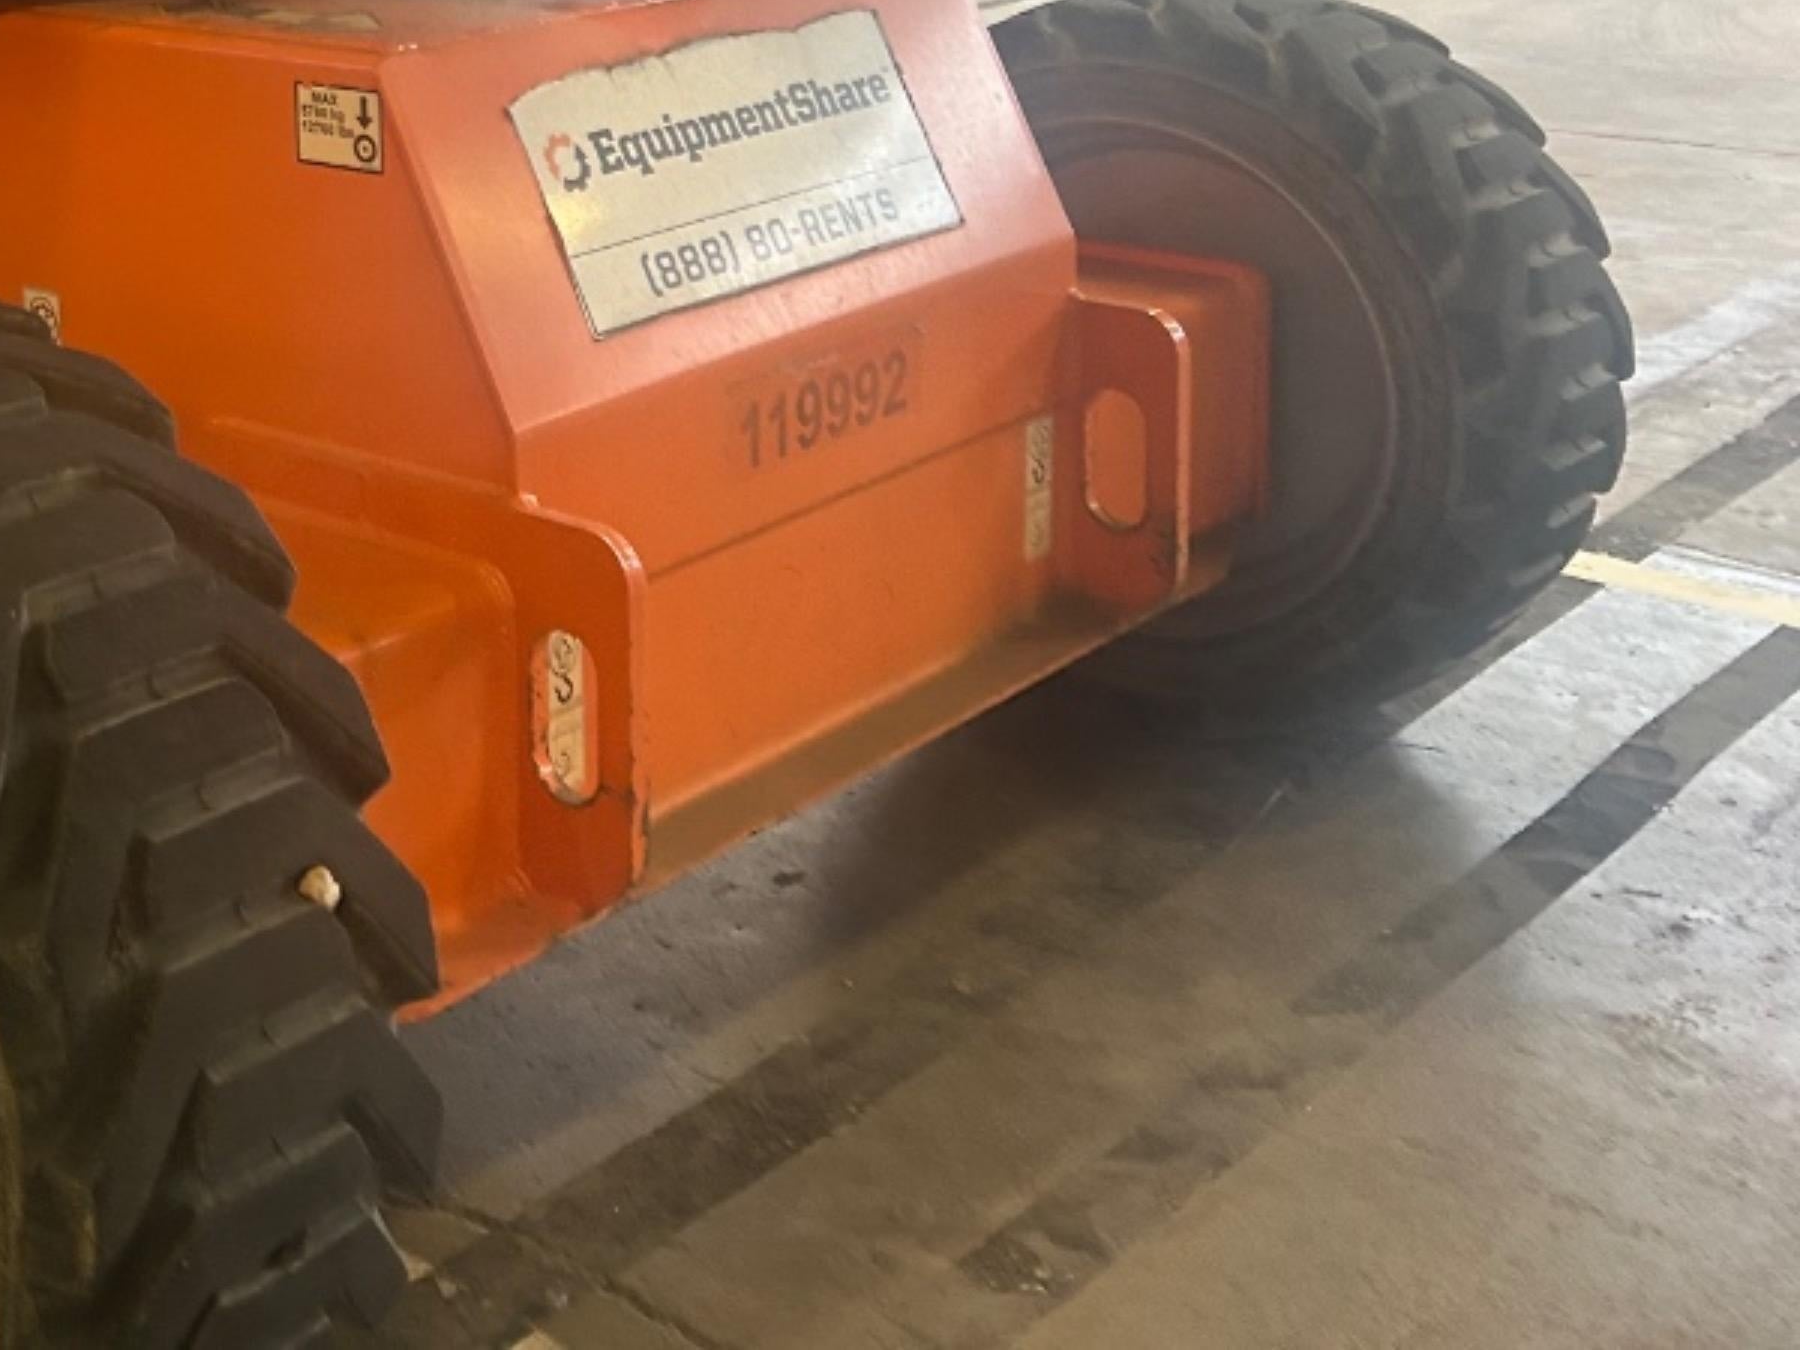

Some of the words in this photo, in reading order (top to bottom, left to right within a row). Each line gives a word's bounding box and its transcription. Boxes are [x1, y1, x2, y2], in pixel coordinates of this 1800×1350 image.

[588, 71, 892, 178] EquipmentShare
[641, 228, 738, 298] (888)
[745, 186, 900, 262] 80-RENTS
[739, 350, 908, 468] 119992
